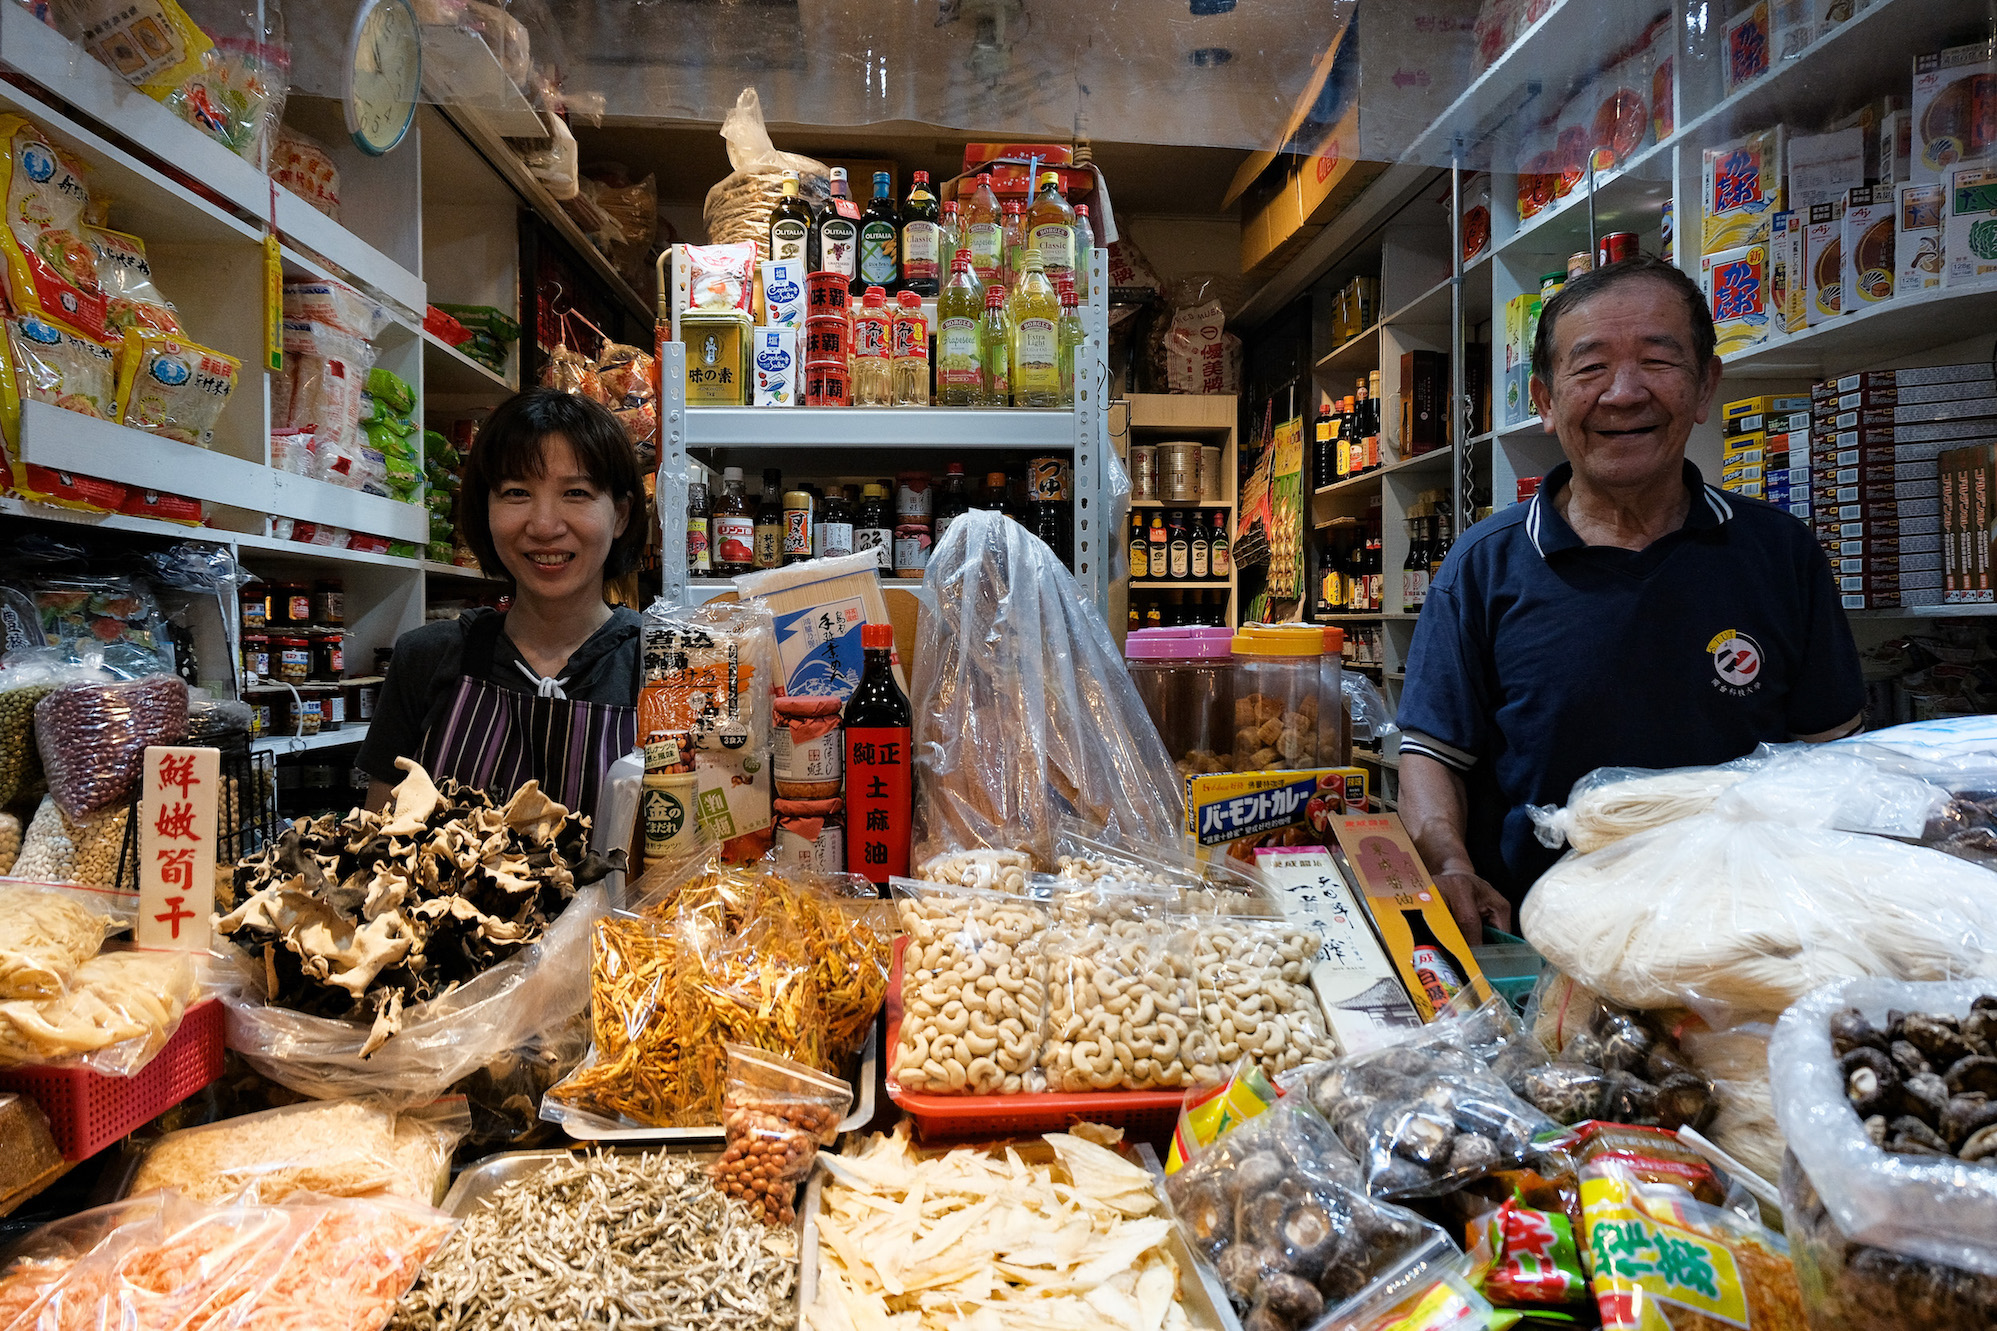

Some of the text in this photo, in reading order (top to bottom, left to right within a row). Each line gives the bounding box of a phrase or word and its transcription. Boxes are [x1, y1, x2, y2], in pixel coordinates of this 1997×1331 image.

[774, 228, 804, 236] OLITALIA
[823, 228, 853, 236] OLITALIA
[864, 232, 893, 240] OLITALIA
[1037, 227, 1069, 238] BORGES
[1039, 242, 1067, 250] Classic
[1749, 249, 1762, 263] 新
[768, 284, 800, 298] Cooking
[1723, 263, 1760, 314] かつお
[779, 292, 796, 303] Salt
[1716, 285, 1734, 320] ちゃん
[944, 318, 973, 330] BORGES
[1022, 320, 1052, 331] BORGES
[866, 322, 883, 348] みりん
[897, 322, 914, 348] みりん
[941, 335, 976, 347] Grapeseed
[757, 353, 791, 366] Cooking
[769, 360, 787, 371] Salt
[689, 367, 733, 384] 味の素
[1201, 342, 1224, 394] 優美牌
[1038, 461, 1062, 498] つゆ
[763, 533, 775, 561] 純米酢
[823, 733, 833, 776] 荒ほぐし
[853, 742, 901, 767] 純正
[807, 762, 824, 777] 鮭
[646, 790, 682, 822] 金の
[1202, 786, 1310, 835] バーモントカレー
[864, 775, 890, 865] 土麻油
[154, 753, 202, 940] 鮮嫩筍干
